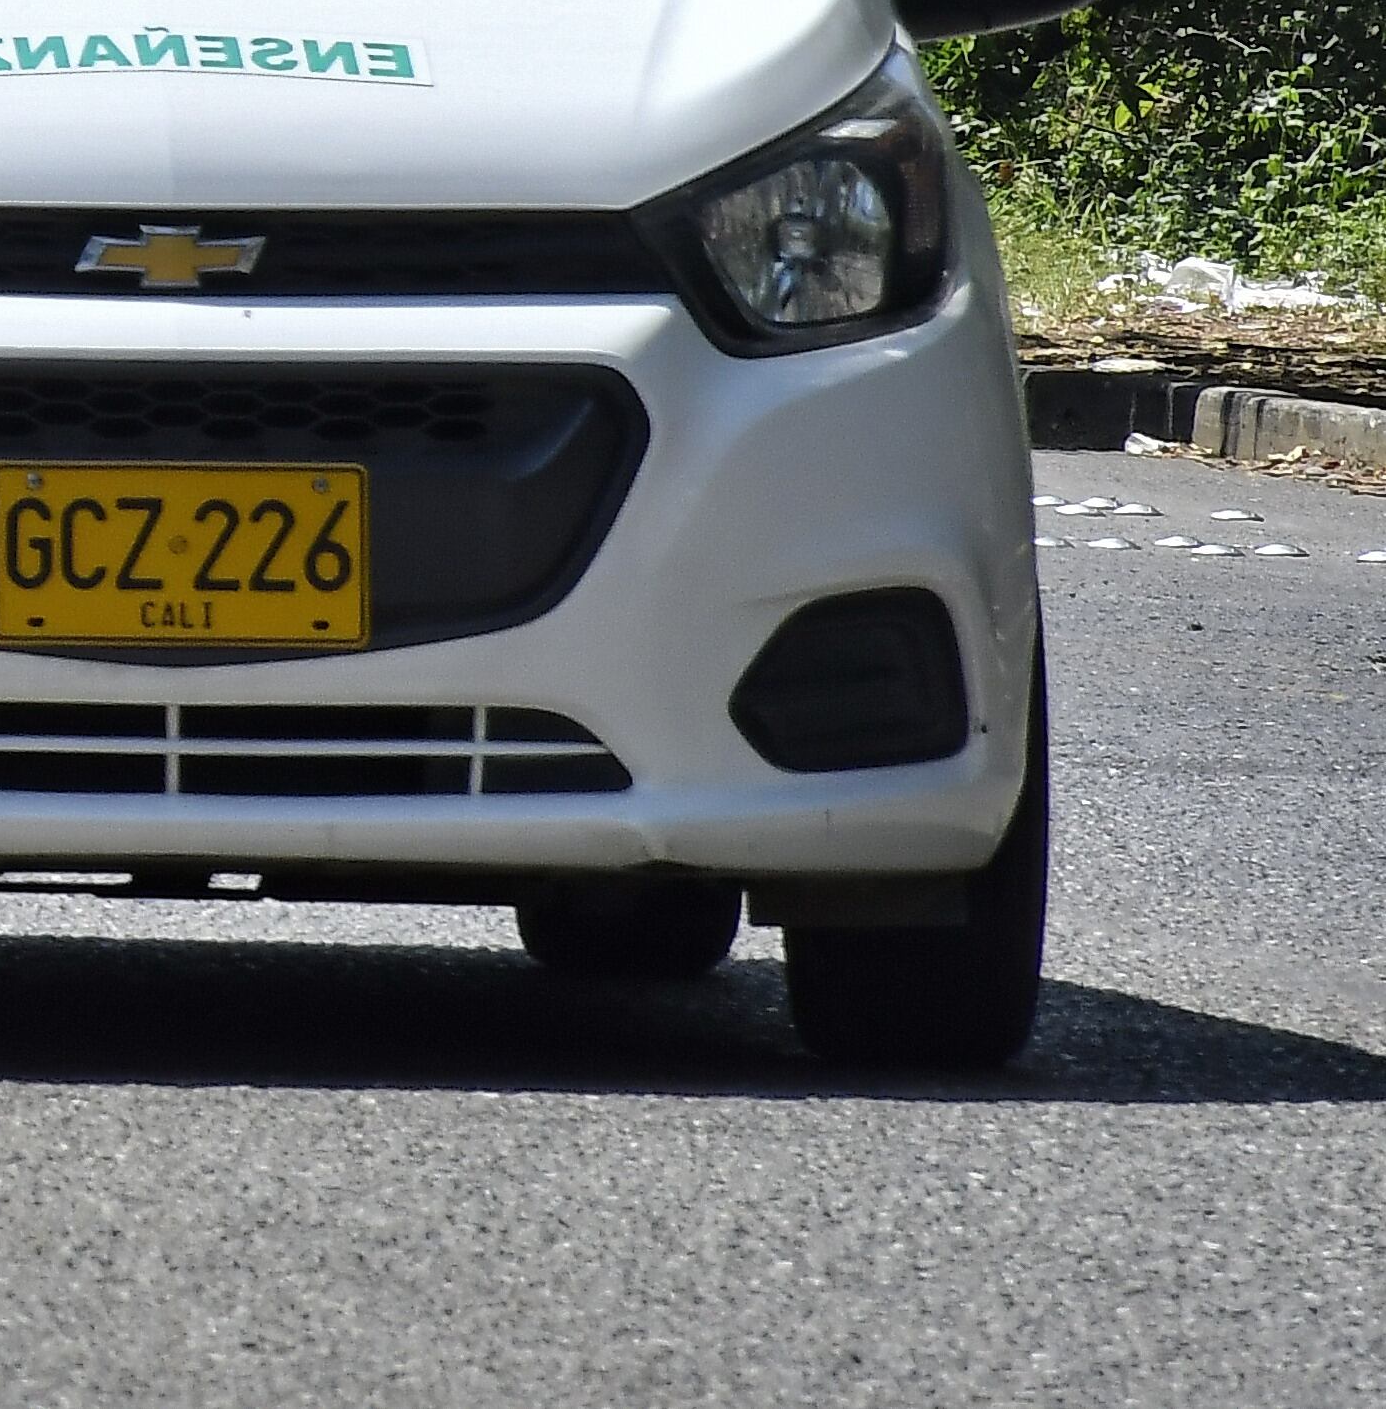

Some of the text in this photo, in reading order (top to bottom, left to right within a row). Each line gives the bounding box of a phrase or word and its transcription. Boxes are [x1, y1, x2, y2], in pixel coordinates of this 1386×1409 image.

[5, 496, 352, 592] GCZ 226
[140, 600, 215, 630] CALI
